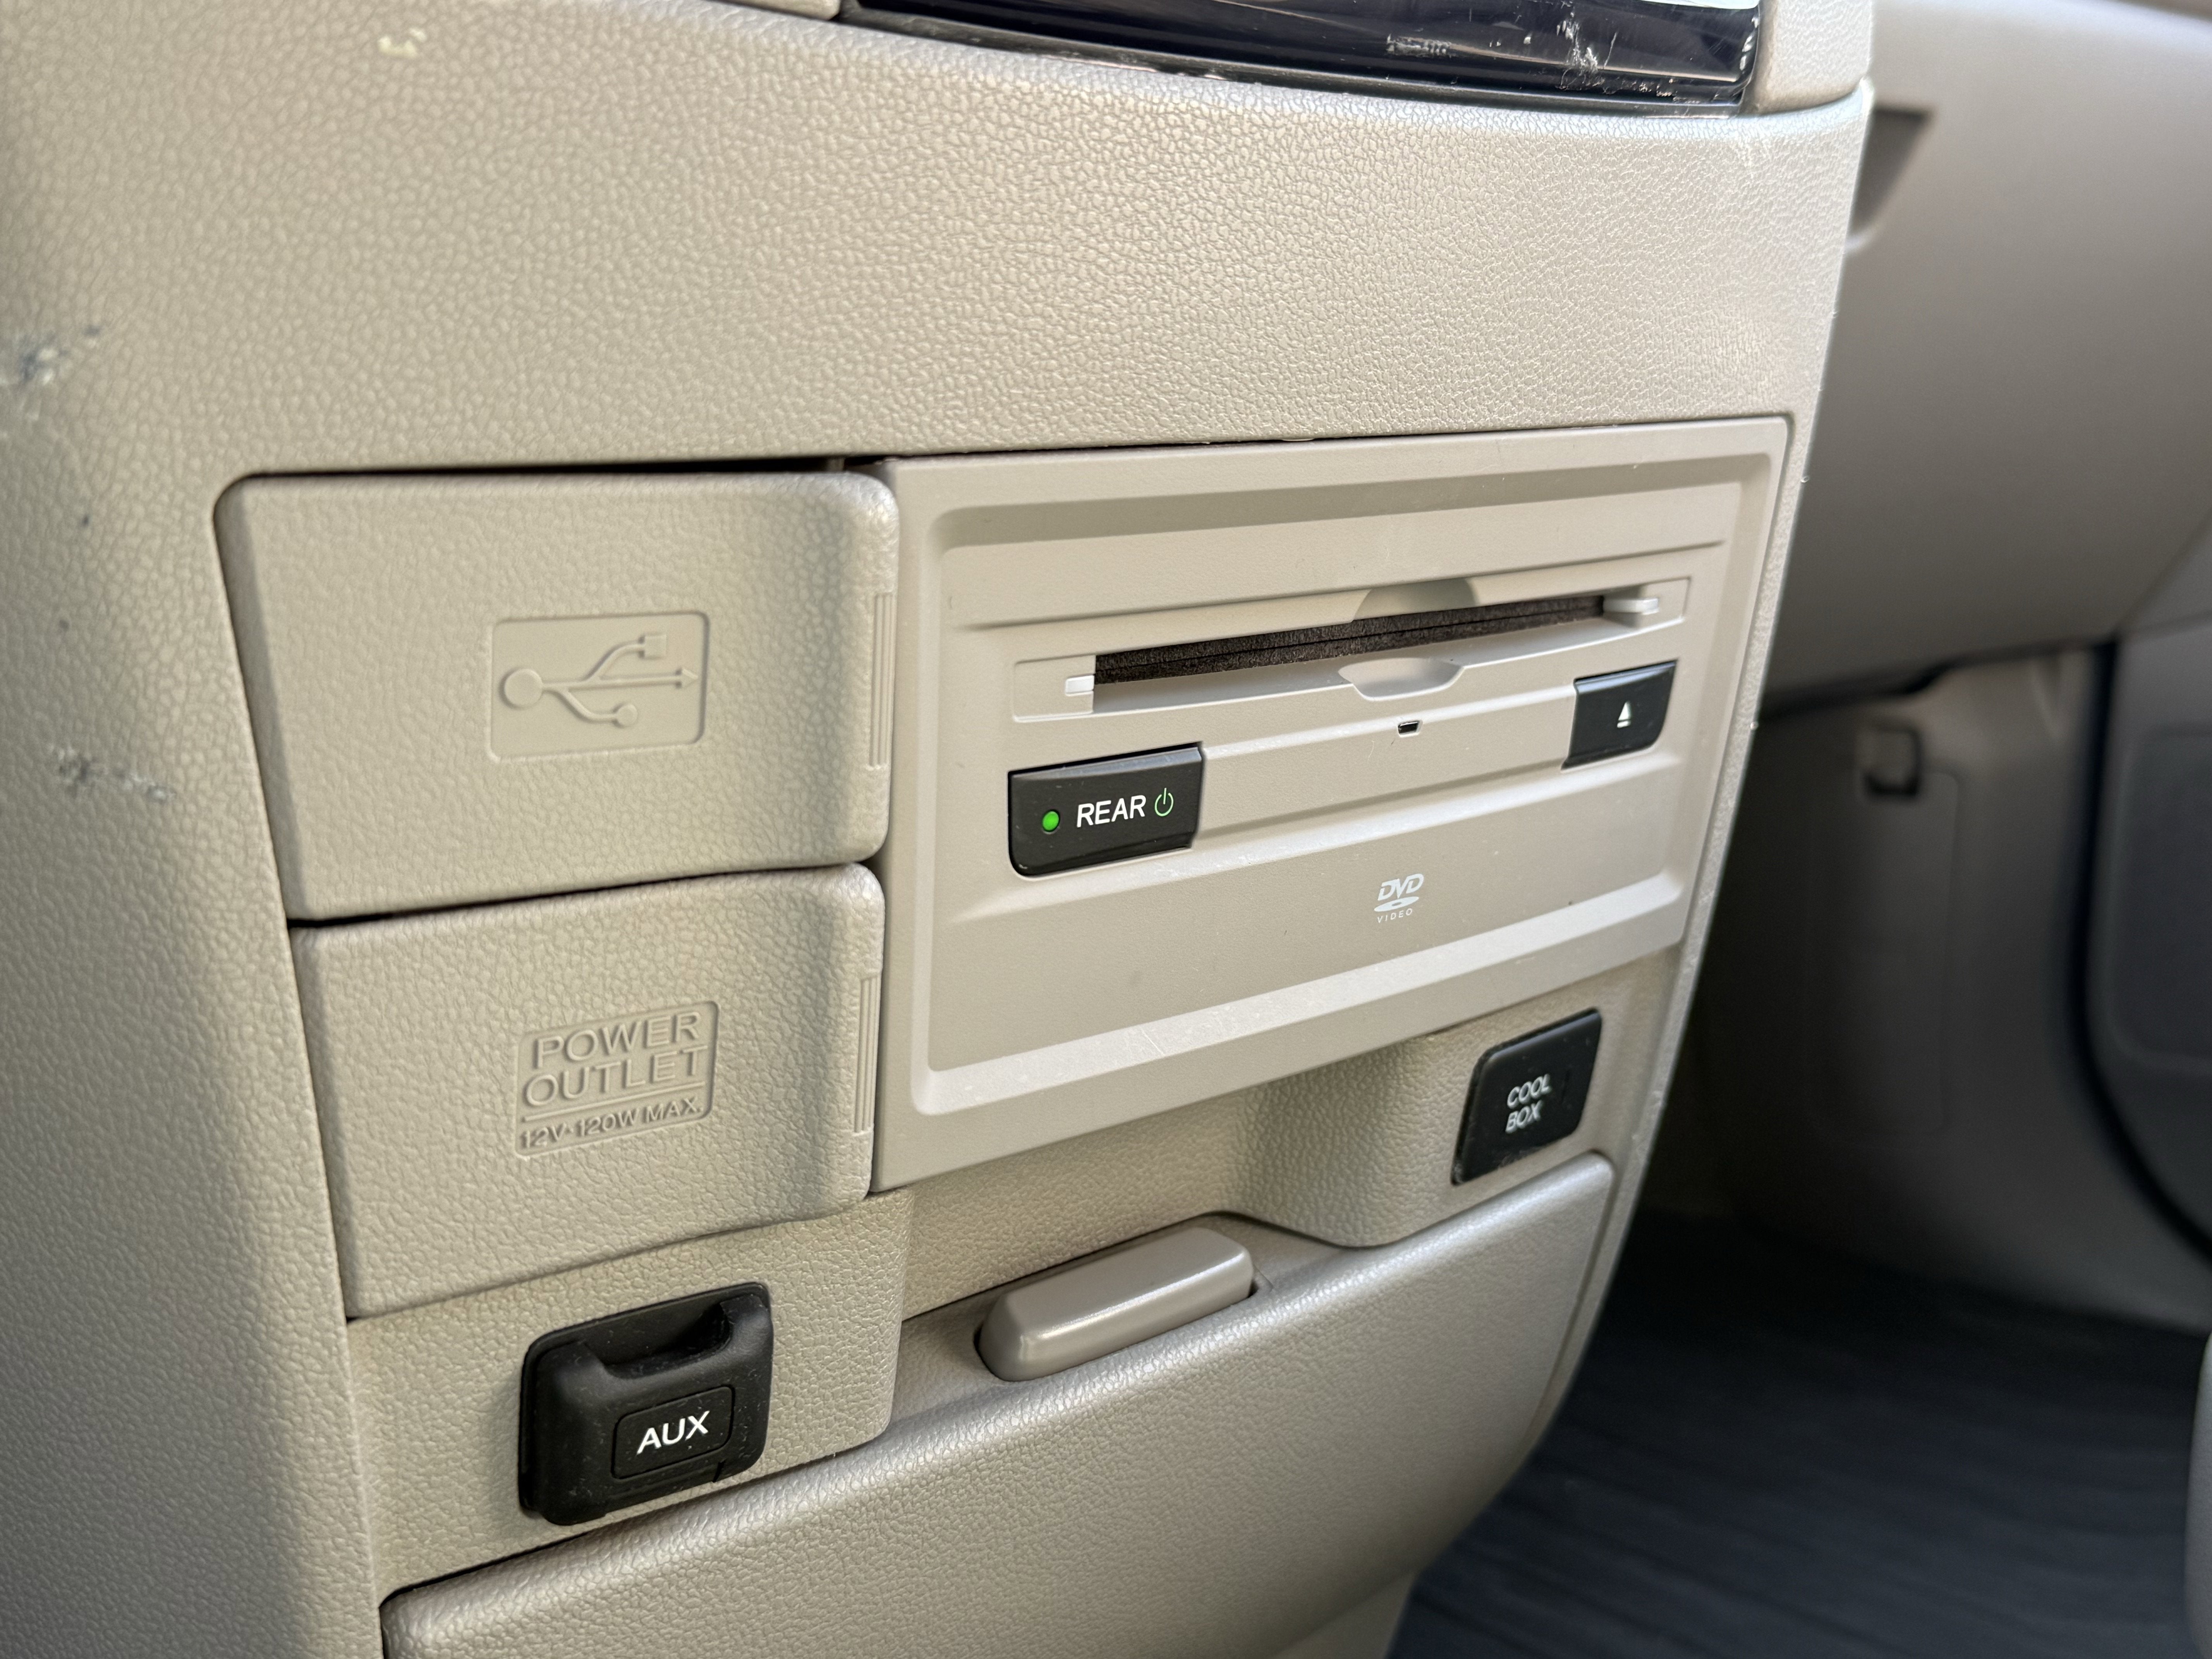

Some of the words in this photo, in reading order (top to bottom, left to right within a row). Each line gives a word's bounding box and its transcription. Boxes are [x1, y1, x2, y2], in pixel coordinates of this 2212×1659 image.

[1077, 795, 1146, 827] REAR
[1377, 873, 1424, 900] DVD
[1377, 908, 1412, 923] VIDEO
[533, 1012, 701, 1068] POWER
[525, 1045, 708, 1106] OUTLET
[1507, 1073, 1551, 1109] COOL
[1505, 1100, 1544, 1134] BOX
[636, 1410, 710, 1455] AUX
